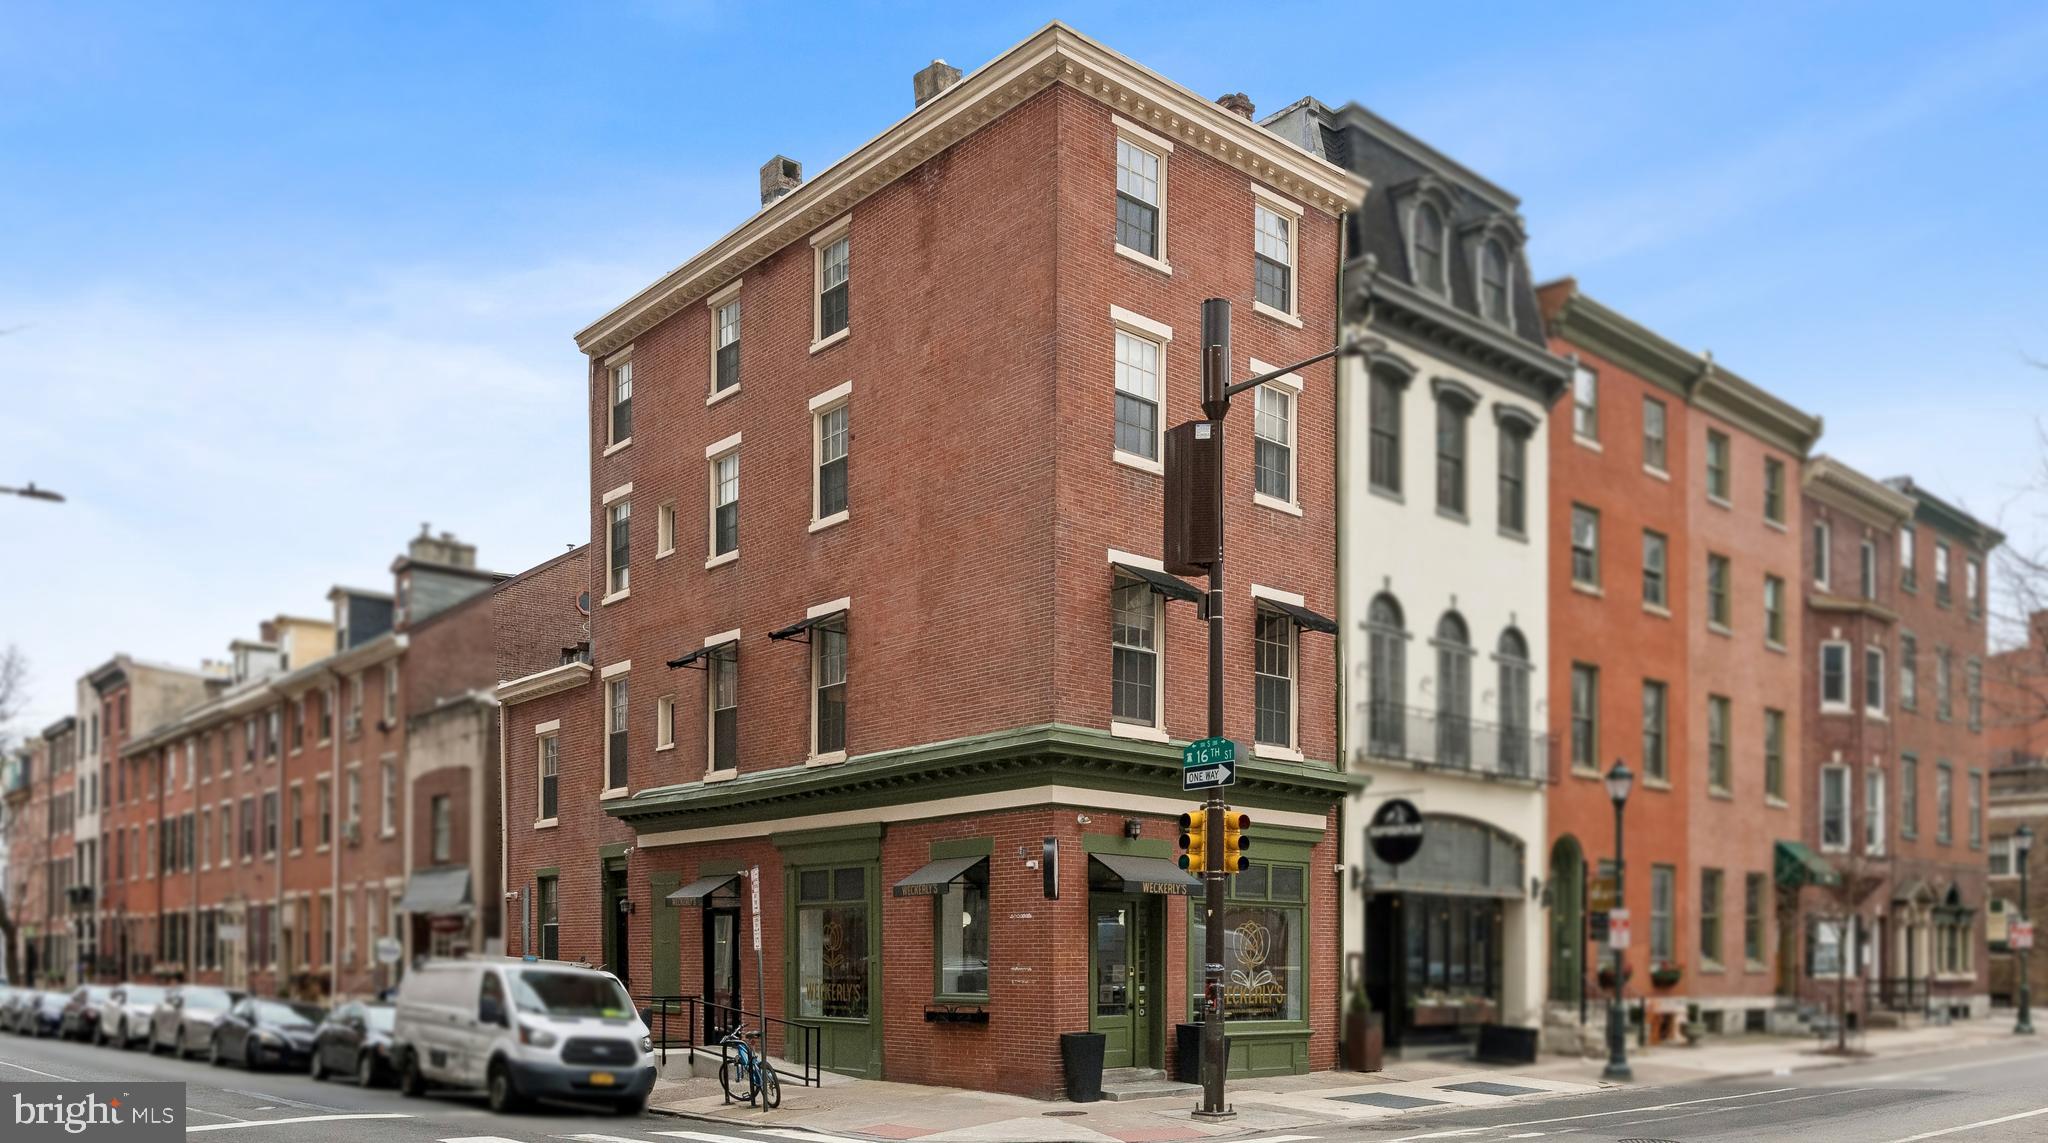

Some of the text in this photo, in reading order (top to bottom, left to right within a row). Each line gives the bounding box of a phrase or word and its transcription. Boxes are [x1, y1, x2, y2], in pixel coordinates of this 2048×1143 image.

[1196, 747, 1232, 764] 16TH ST
[1188, 769, 1219, 783] ONE WAY
[1142, 881, 1187, 895] WECKERLY'S
[806, 983, 861, 1002] WECKERLY'S
[1225, 984, 1284, 1005] ECKERLY'S
